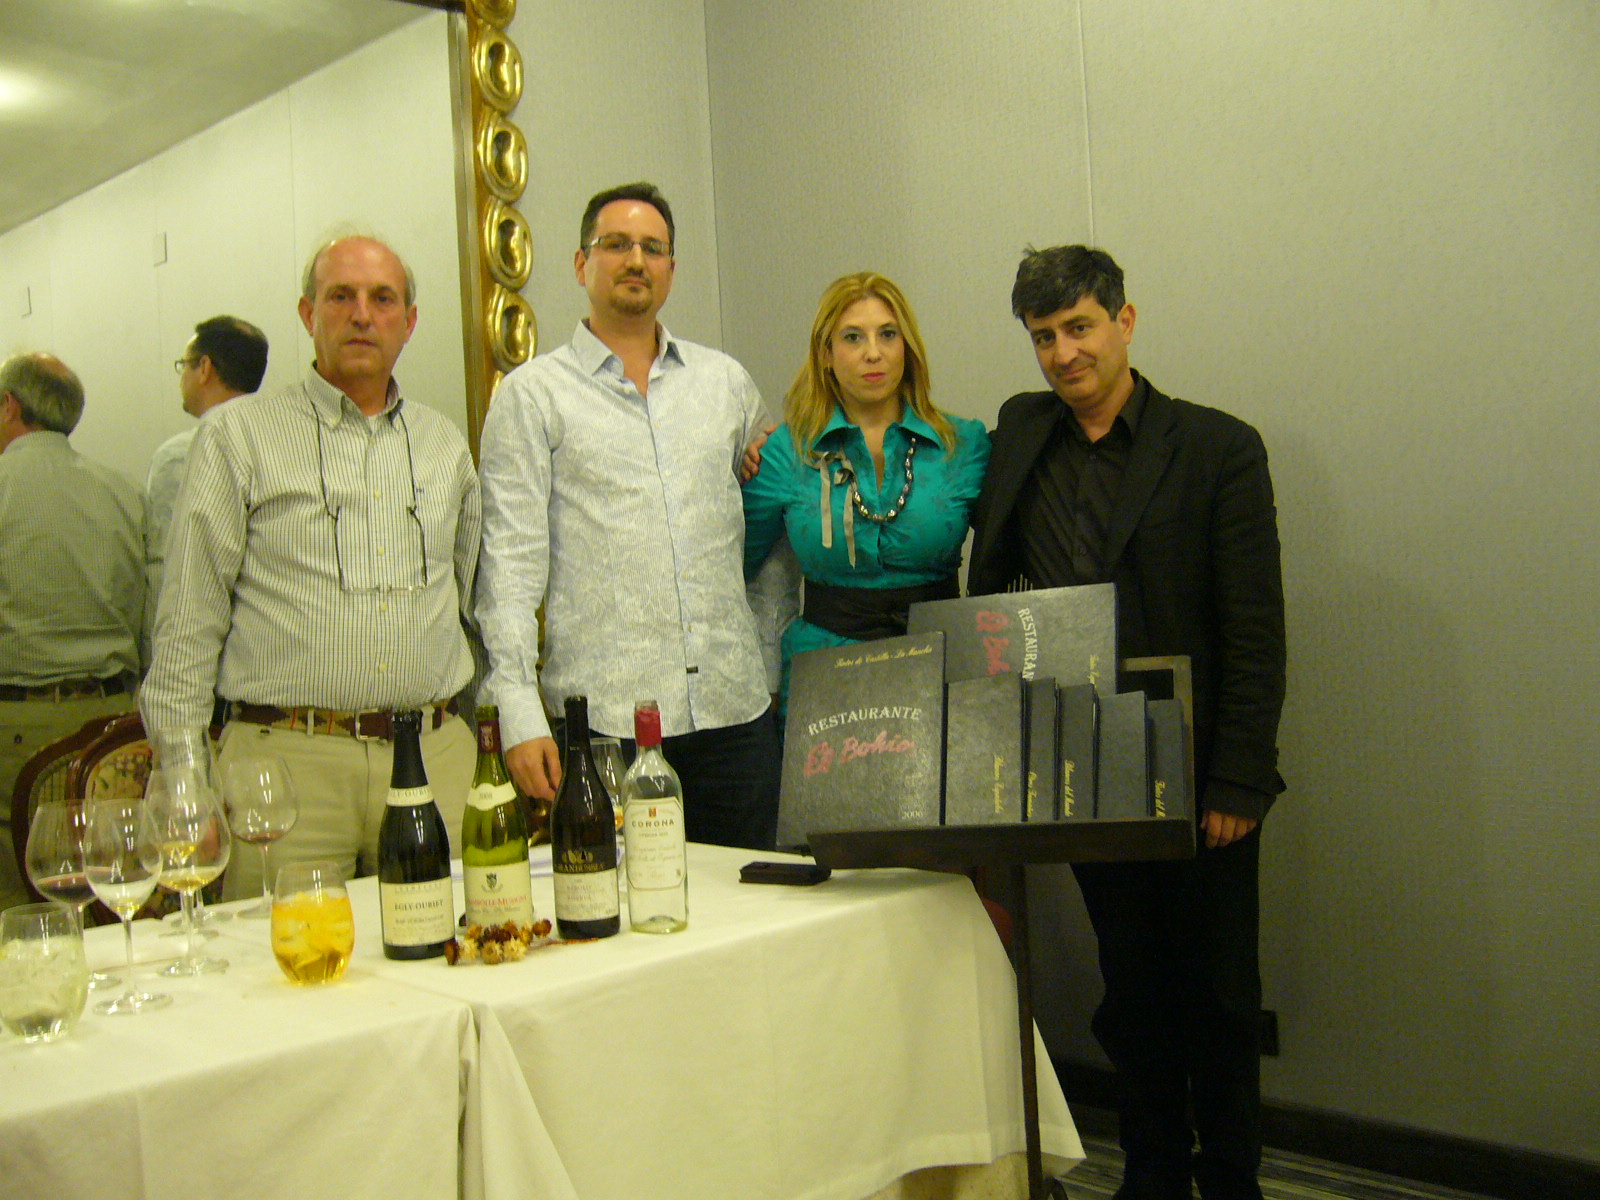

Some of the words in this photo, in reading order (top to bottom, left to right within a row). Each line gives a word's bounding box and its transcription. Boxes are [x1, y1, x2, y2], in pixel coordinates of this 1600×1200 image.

[1018, 607, 1038, 682] RESTAURAN
[808, 706, 922, 736] RESTAURANTE
[631, 819, 675, 828] CORONA
